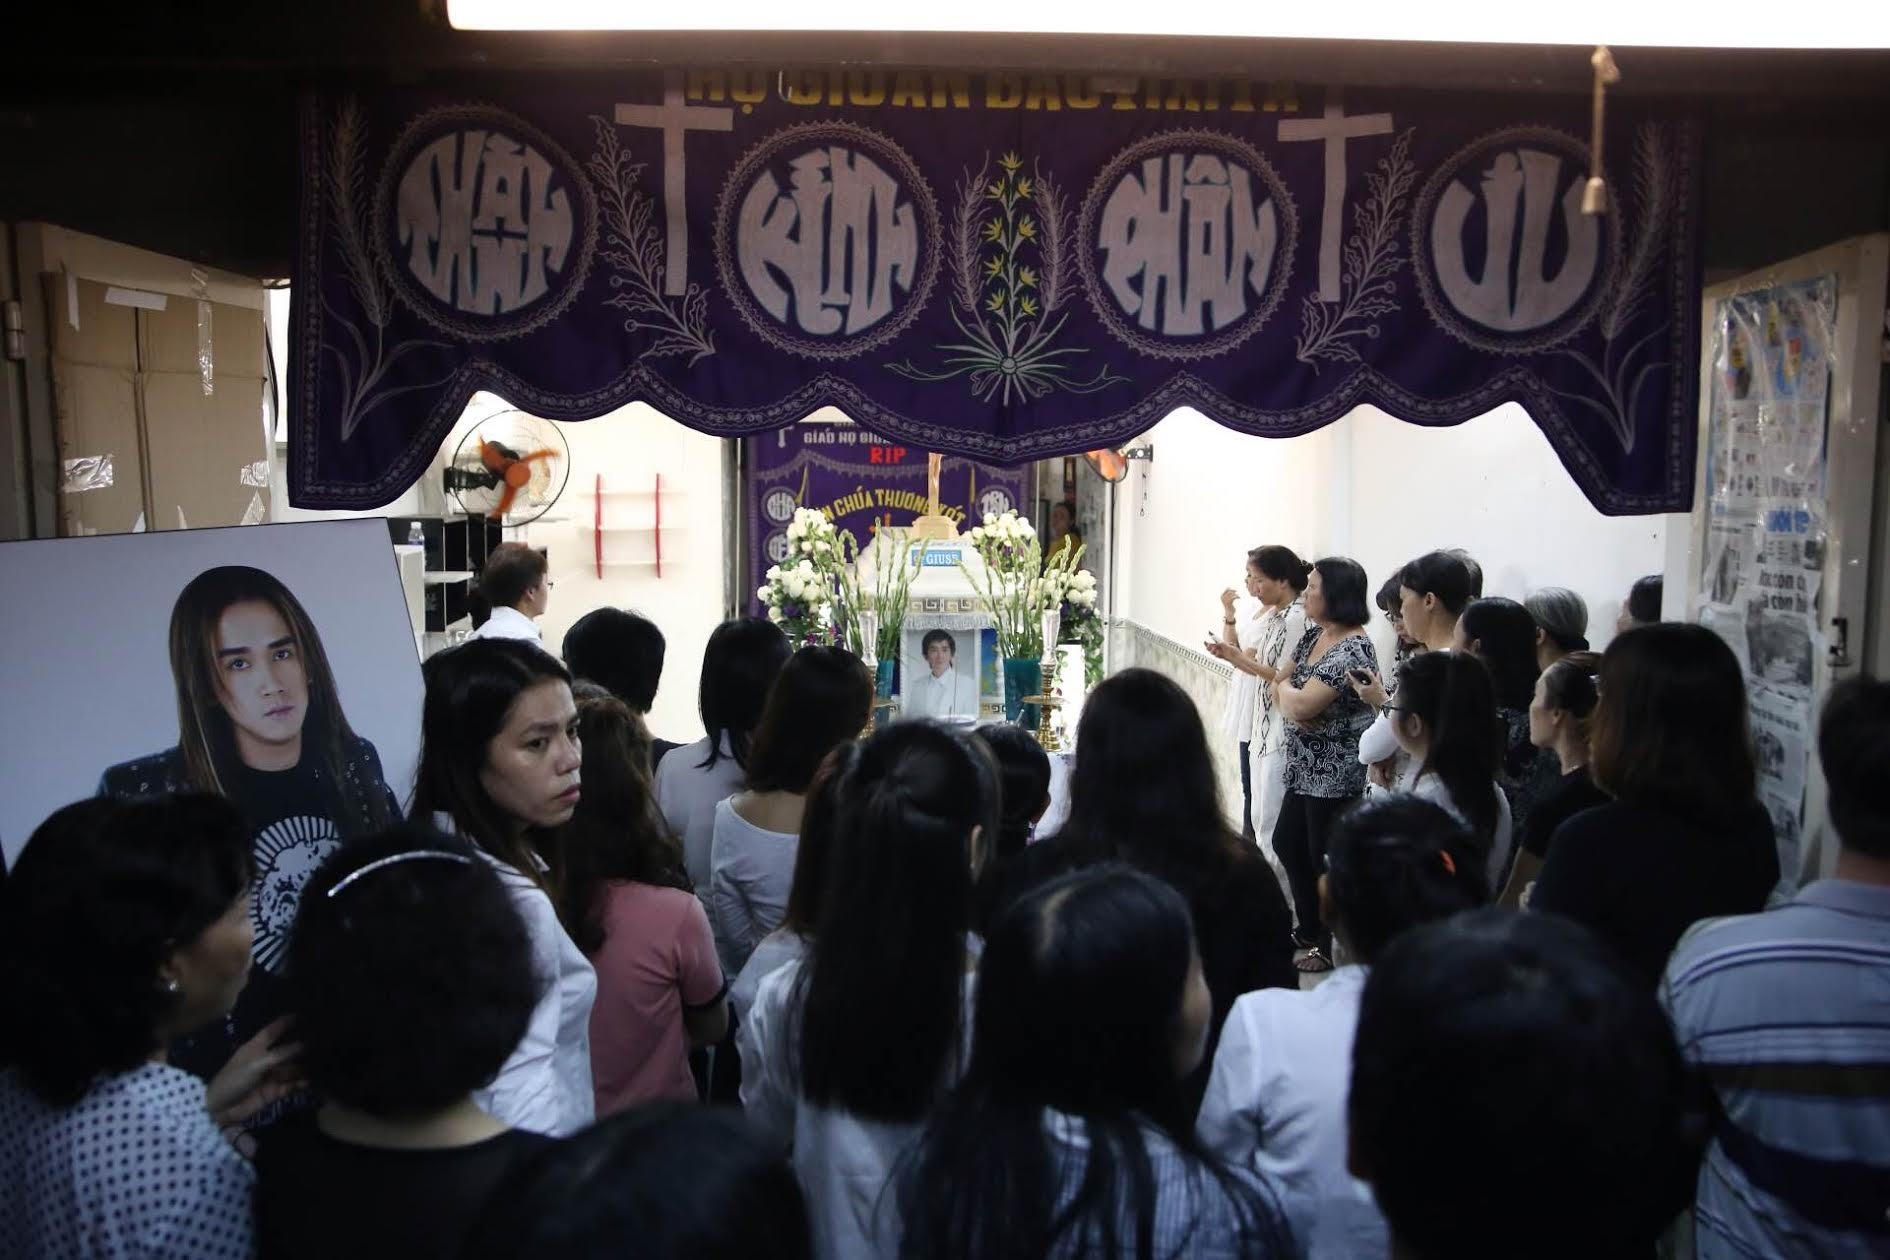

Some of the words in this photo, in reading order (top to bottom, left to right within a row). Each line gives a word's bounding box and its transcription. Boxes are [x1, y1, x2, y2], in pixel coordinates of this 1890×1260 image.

[737, 147, 919, 335] KÍNH
[1099, 154, 1277, 336] PHÂN
[838, 431, 857, 447] HỌ
[869, 446, 907, 464] RIP
[833, 485, 874, 517] CHÚA
